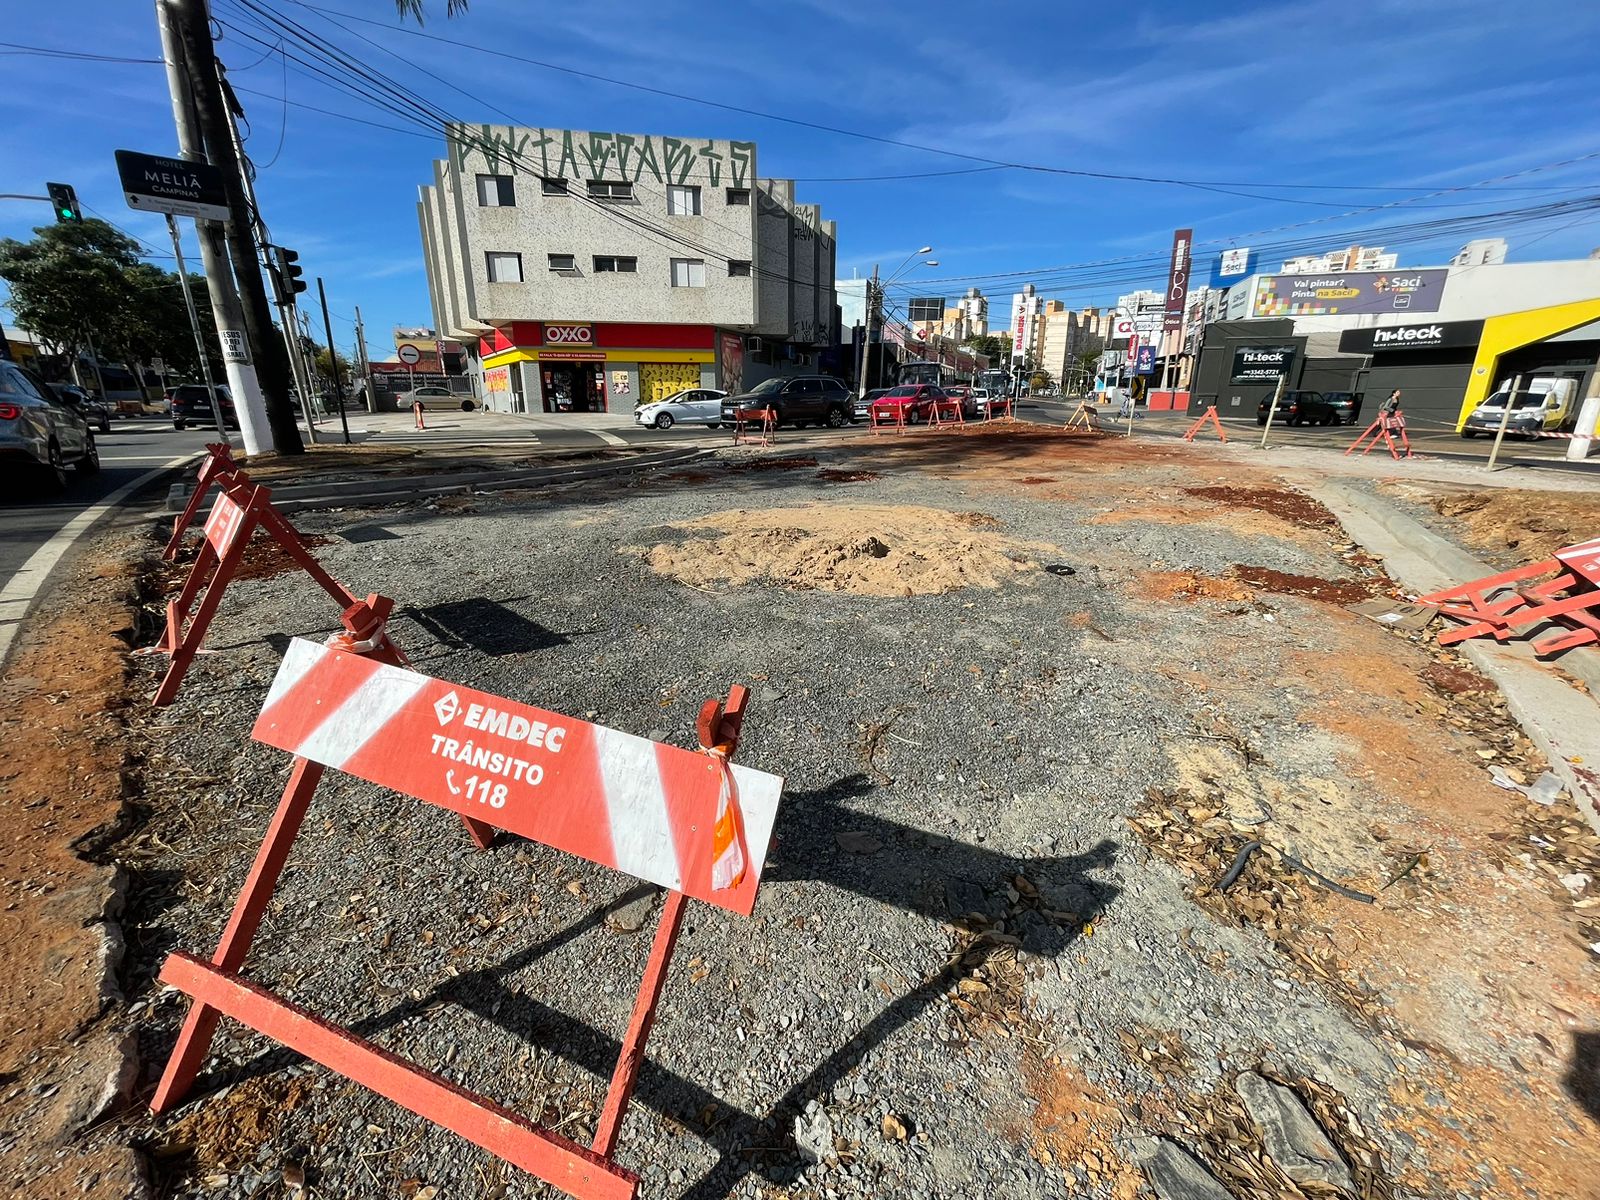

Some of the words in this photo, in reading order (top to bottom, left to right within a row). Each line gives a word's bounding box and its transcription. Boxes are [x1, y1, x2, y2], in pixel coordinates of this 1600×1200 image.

[155, 160, 184, 170] HOTEL
[152, 185, 199, 198] CAMPINAS
[1310, 279, 1345, 289] pintar?
[1391, 275, 1422, 287] Saci
[1291, 290, 1316, 298] Pinta
[546, 327, 591, 342] OXXO
[1016, 316, 1025, 350] DALBEN
[464, 703, 566, 752] EMDEC
[431, 734, 544, 785] TRÂNSITO
[465, 775, 508, 808] 118
